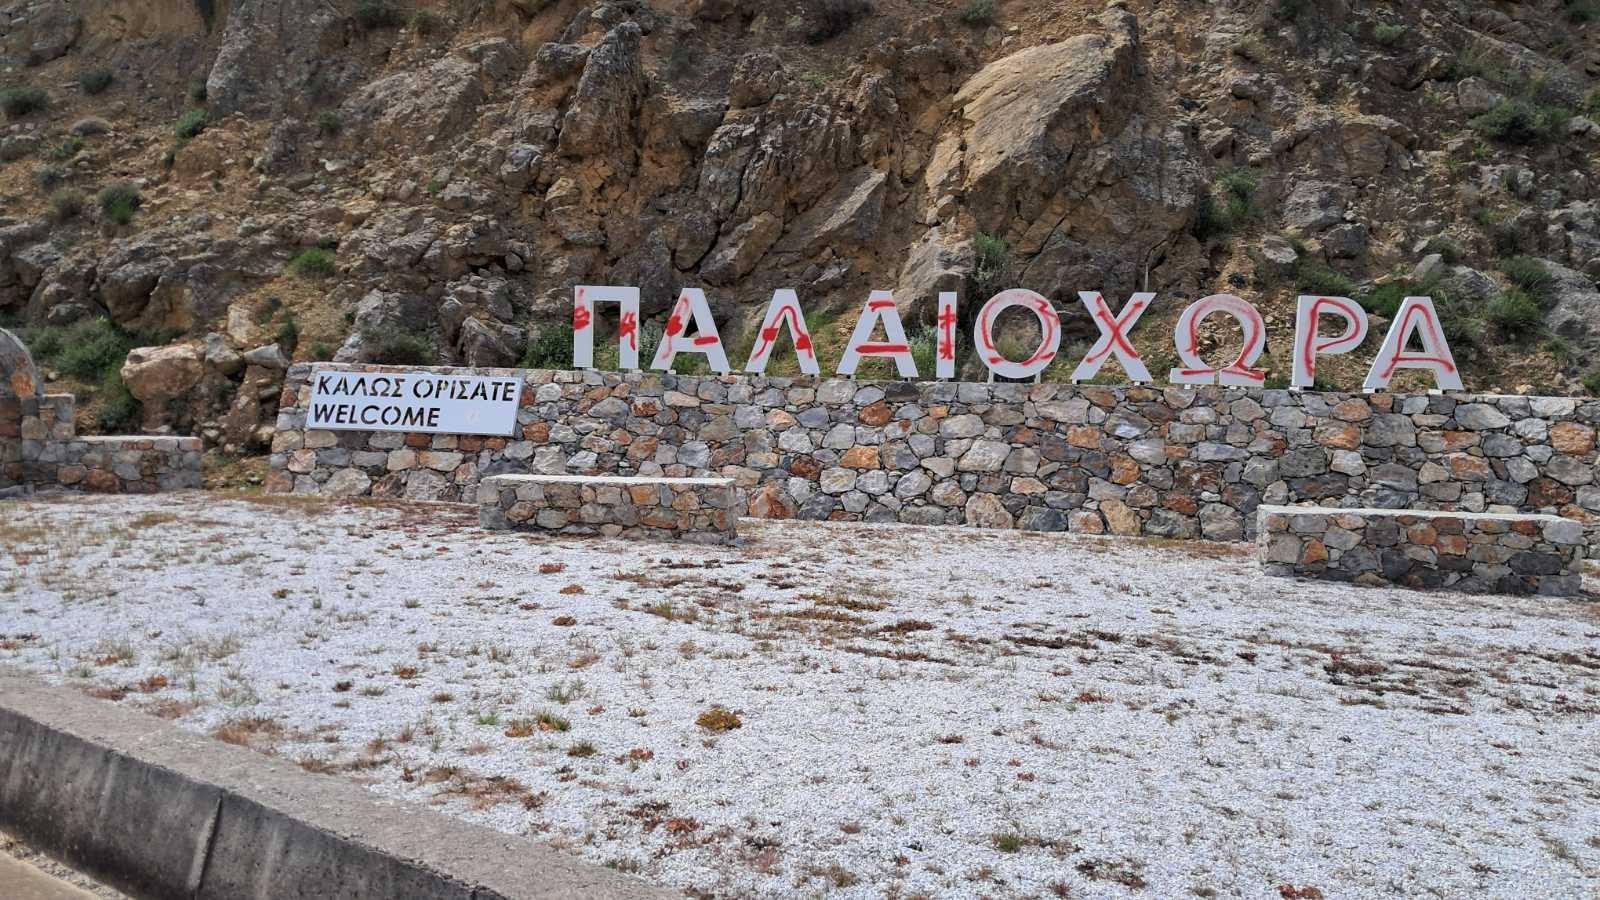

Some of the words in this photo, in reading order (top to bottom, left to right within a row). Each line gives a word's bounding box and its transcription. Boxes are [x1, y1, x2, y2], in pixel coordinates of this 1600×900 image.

[573, 285, 1464, 391] ΠΑΛΑΙΟΧΩΡΑ
[317, 376, 405, 398] ΚΑΛΩΣ
[413, 379, 516, 401] ΟΡΙΣΑΤΕ
[313, 404, 441, 427] WELCOME
